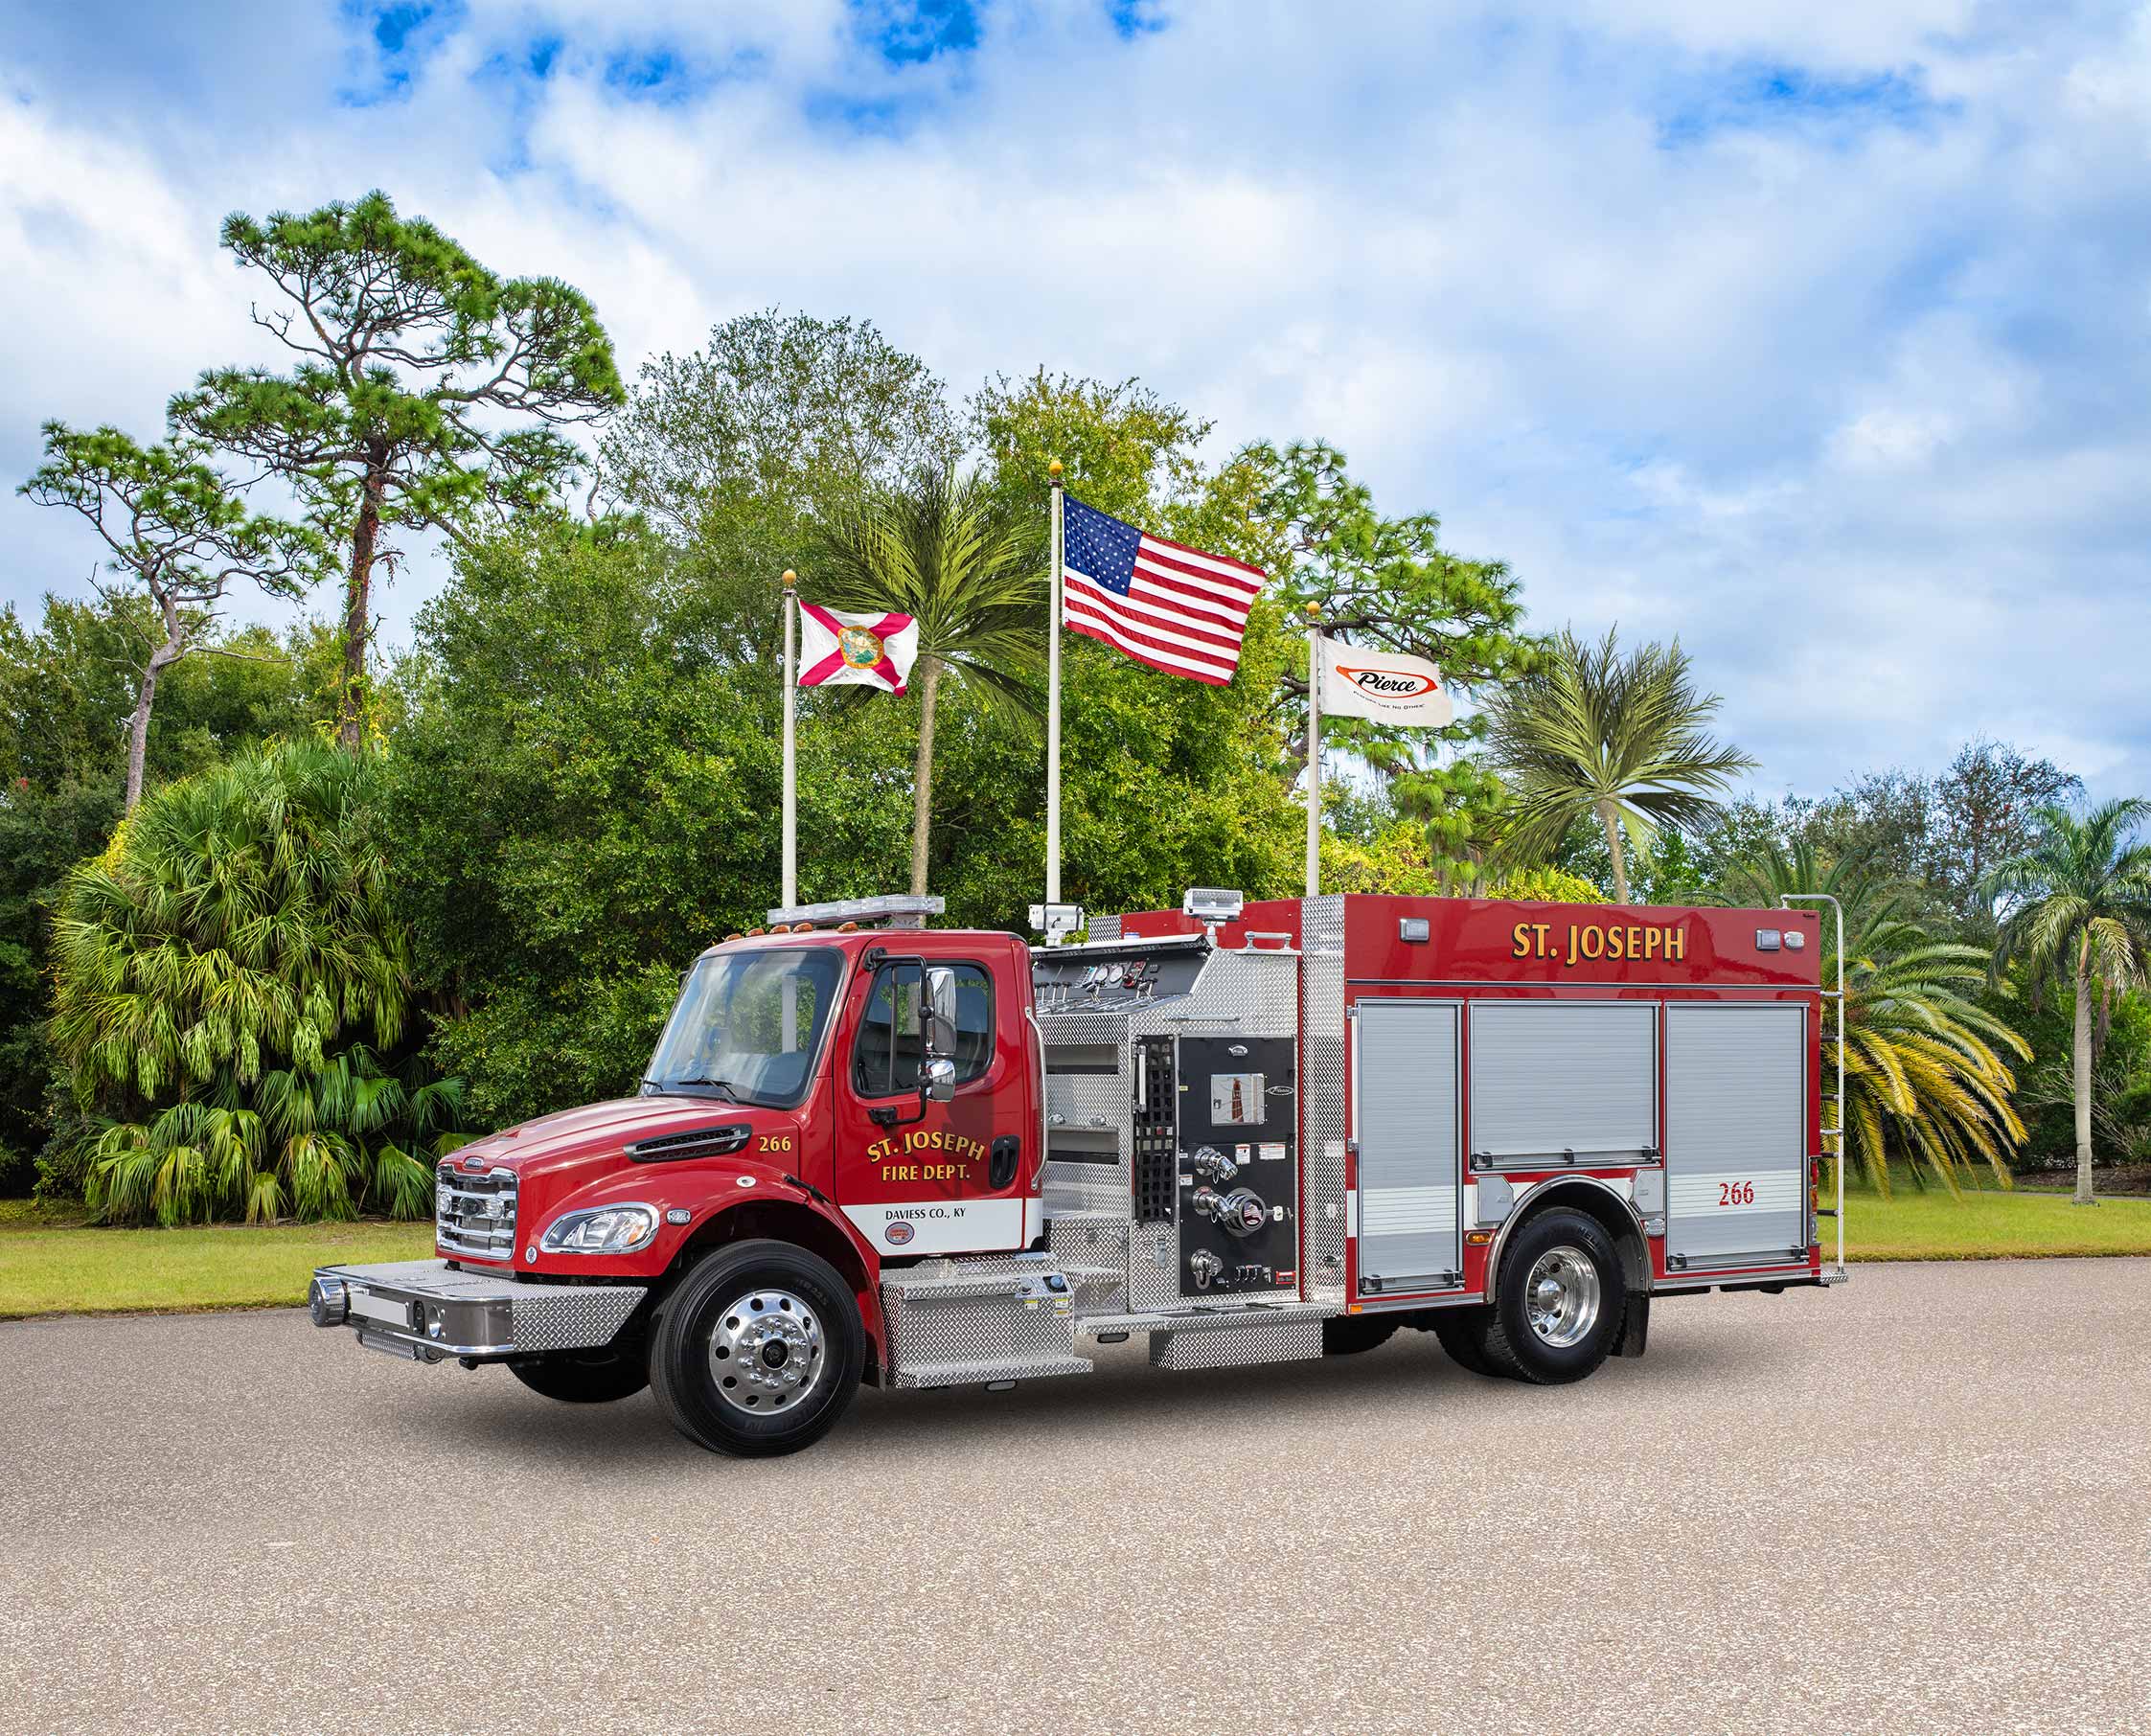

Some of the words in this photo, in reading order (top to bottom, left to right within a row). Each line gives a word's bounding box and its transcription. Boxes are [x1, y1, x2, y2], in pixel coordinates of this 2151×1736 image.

[1358, 672, 1416, 692] Pierce
[1512, 923, 1558, 958] ST.
[1565, 925, 1684, 967] JOSEPH
[759, 1136, 791, 1152] 266
[867, 1137, 899, 1162] ST.
[904, 1131, 985, 1161] JOSEPH
[882, 1165, 919, 1181] FIRE
[923, 1164, 971, 1180] DEPT.
[1719, 1180, 1754, 1205] 266
[885, 1209, 927, 1221] DAVIESS
[928, 1208, 950, 1219] CO.,
[953, 1207, 967, 1218] KY
